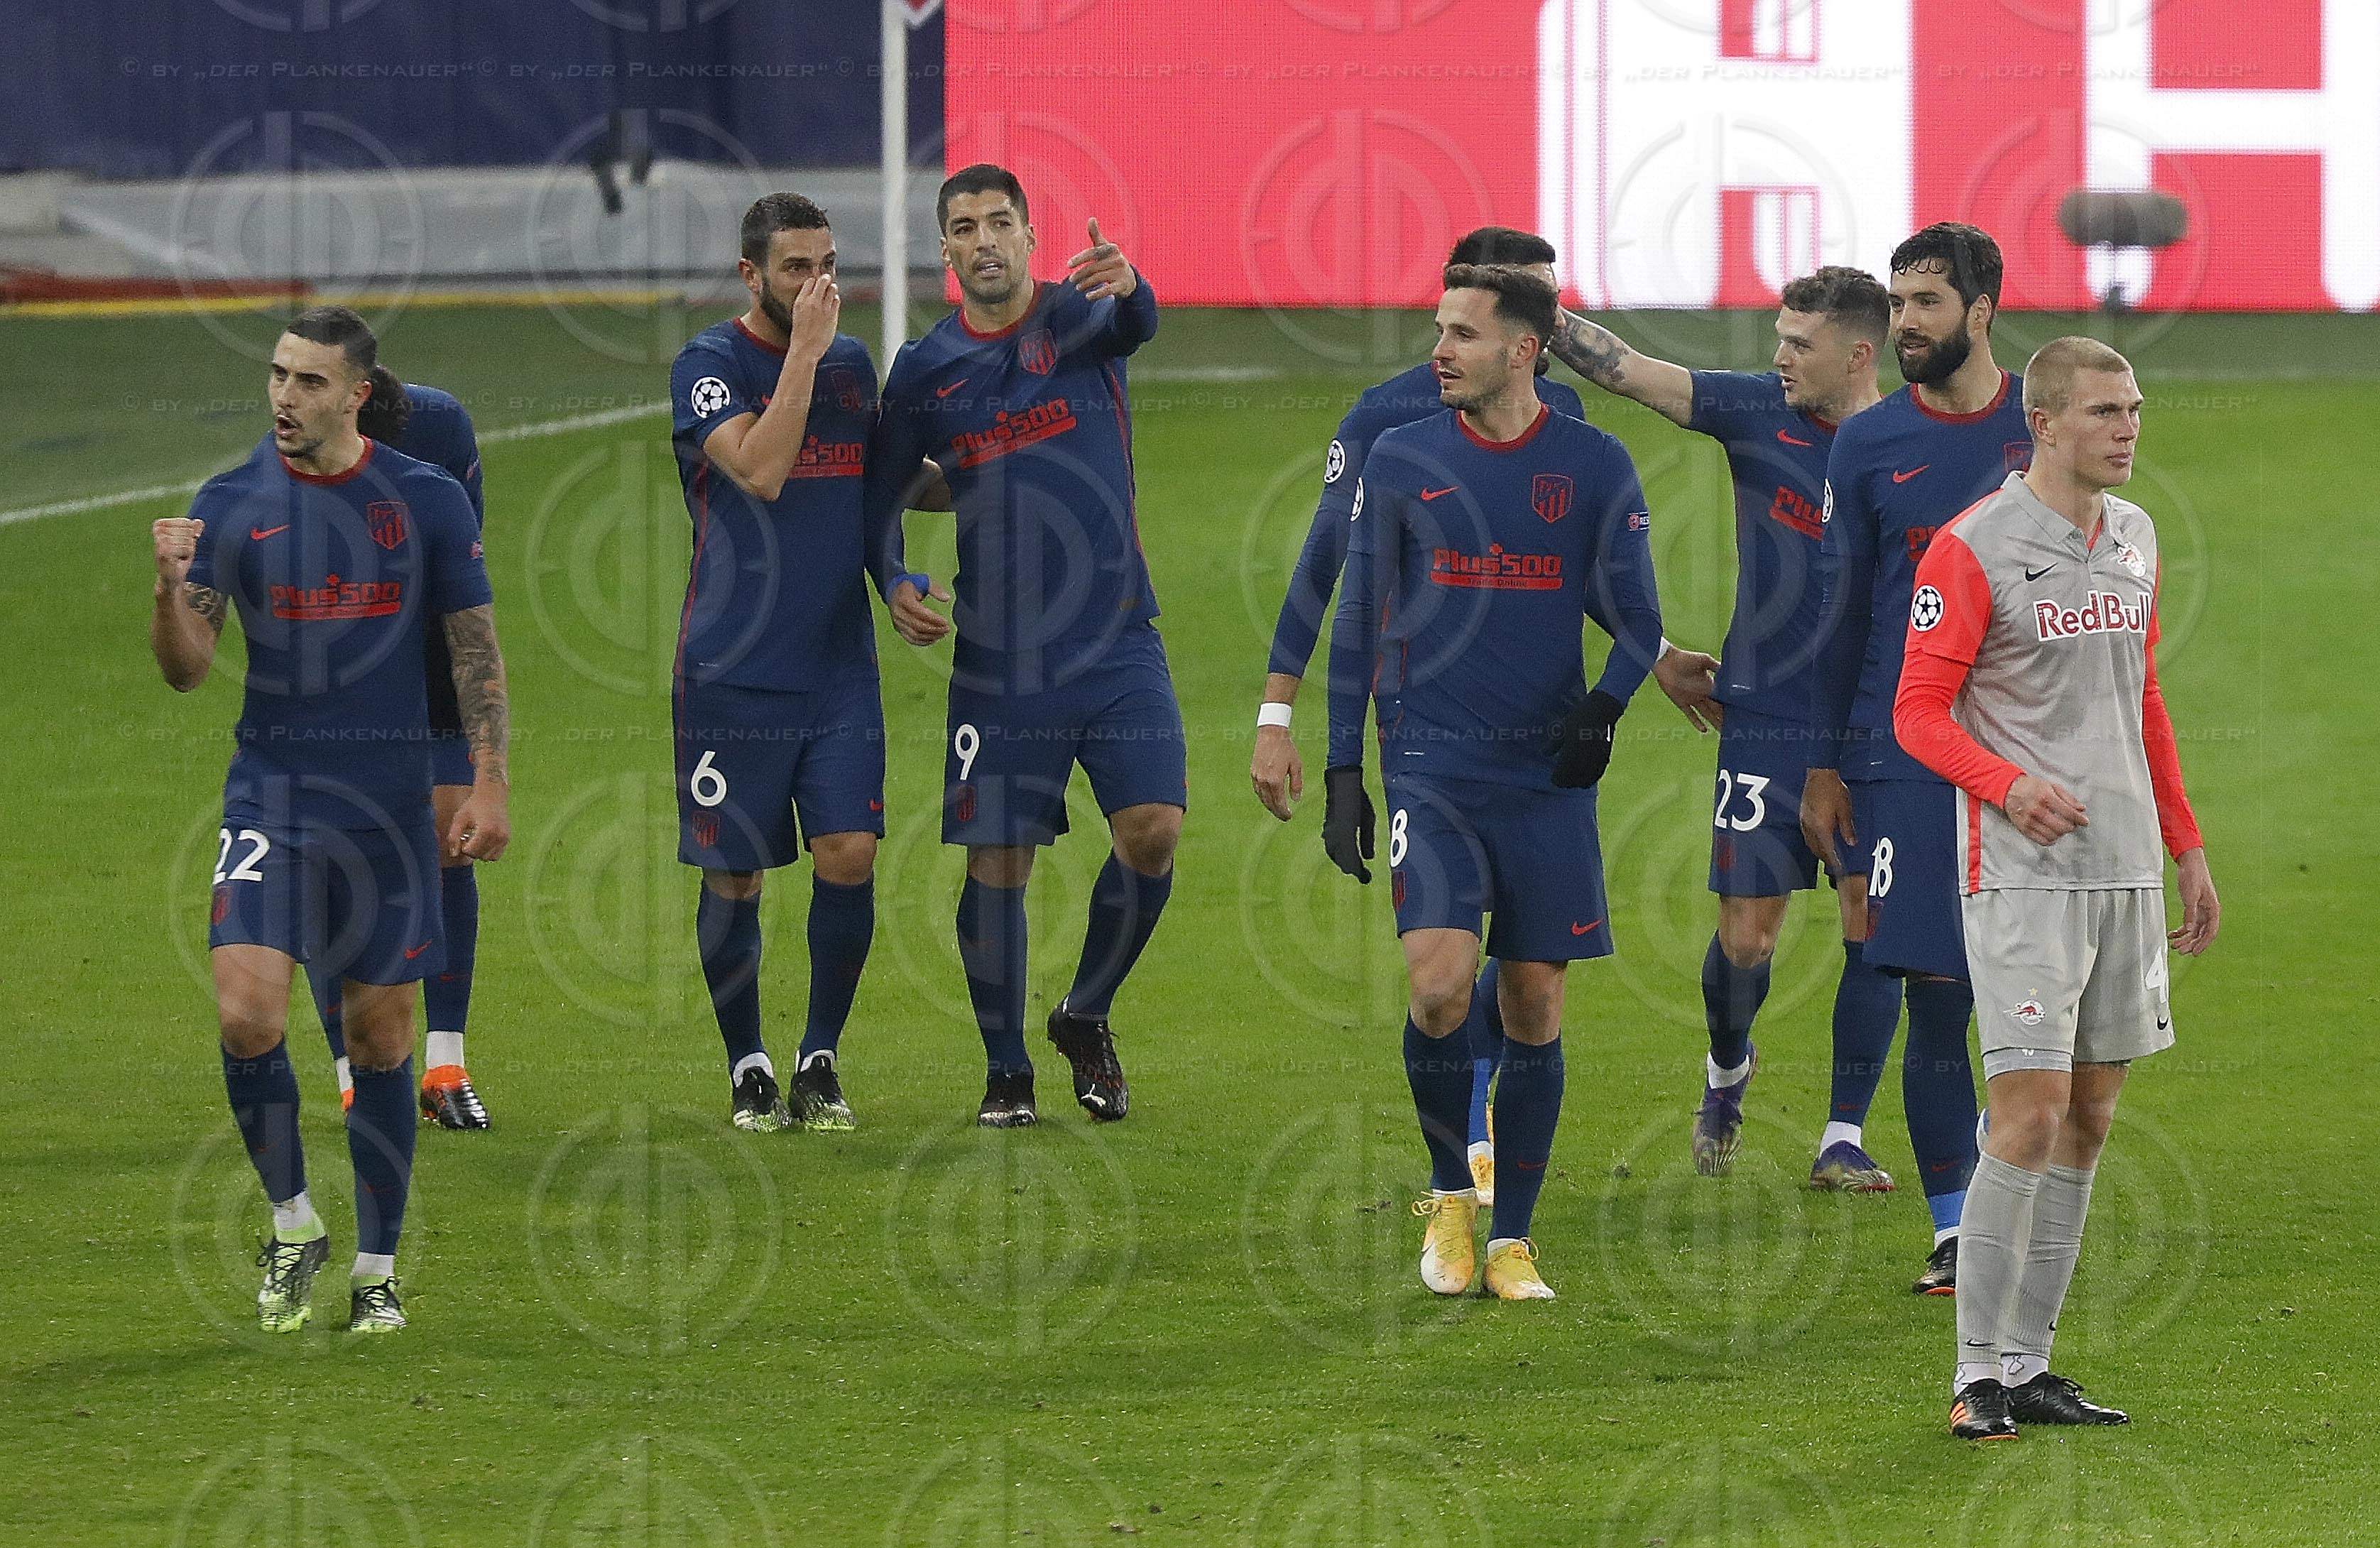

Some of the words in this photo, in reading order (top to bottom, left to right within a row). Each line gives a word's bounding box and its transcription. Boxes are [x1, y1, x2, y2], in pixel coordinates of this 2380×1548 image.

[796, 435, 864, 464] s500
[951, 397, 1069, 453] Plus500
[1433, 543, 1562, 577] Plus500
[268, 572, 403, 606] Plus500
[690, 750, 728, 807] 6
[954, 724, 981, 780] 9
[1714, 768, 1771, 832] 23
[212, 827, 271, 885] 22
[1390, 808, 1409, 868] 8
[1868, 836, 1894, 898] 18
[2144, 945, 2168, 1005] 4
